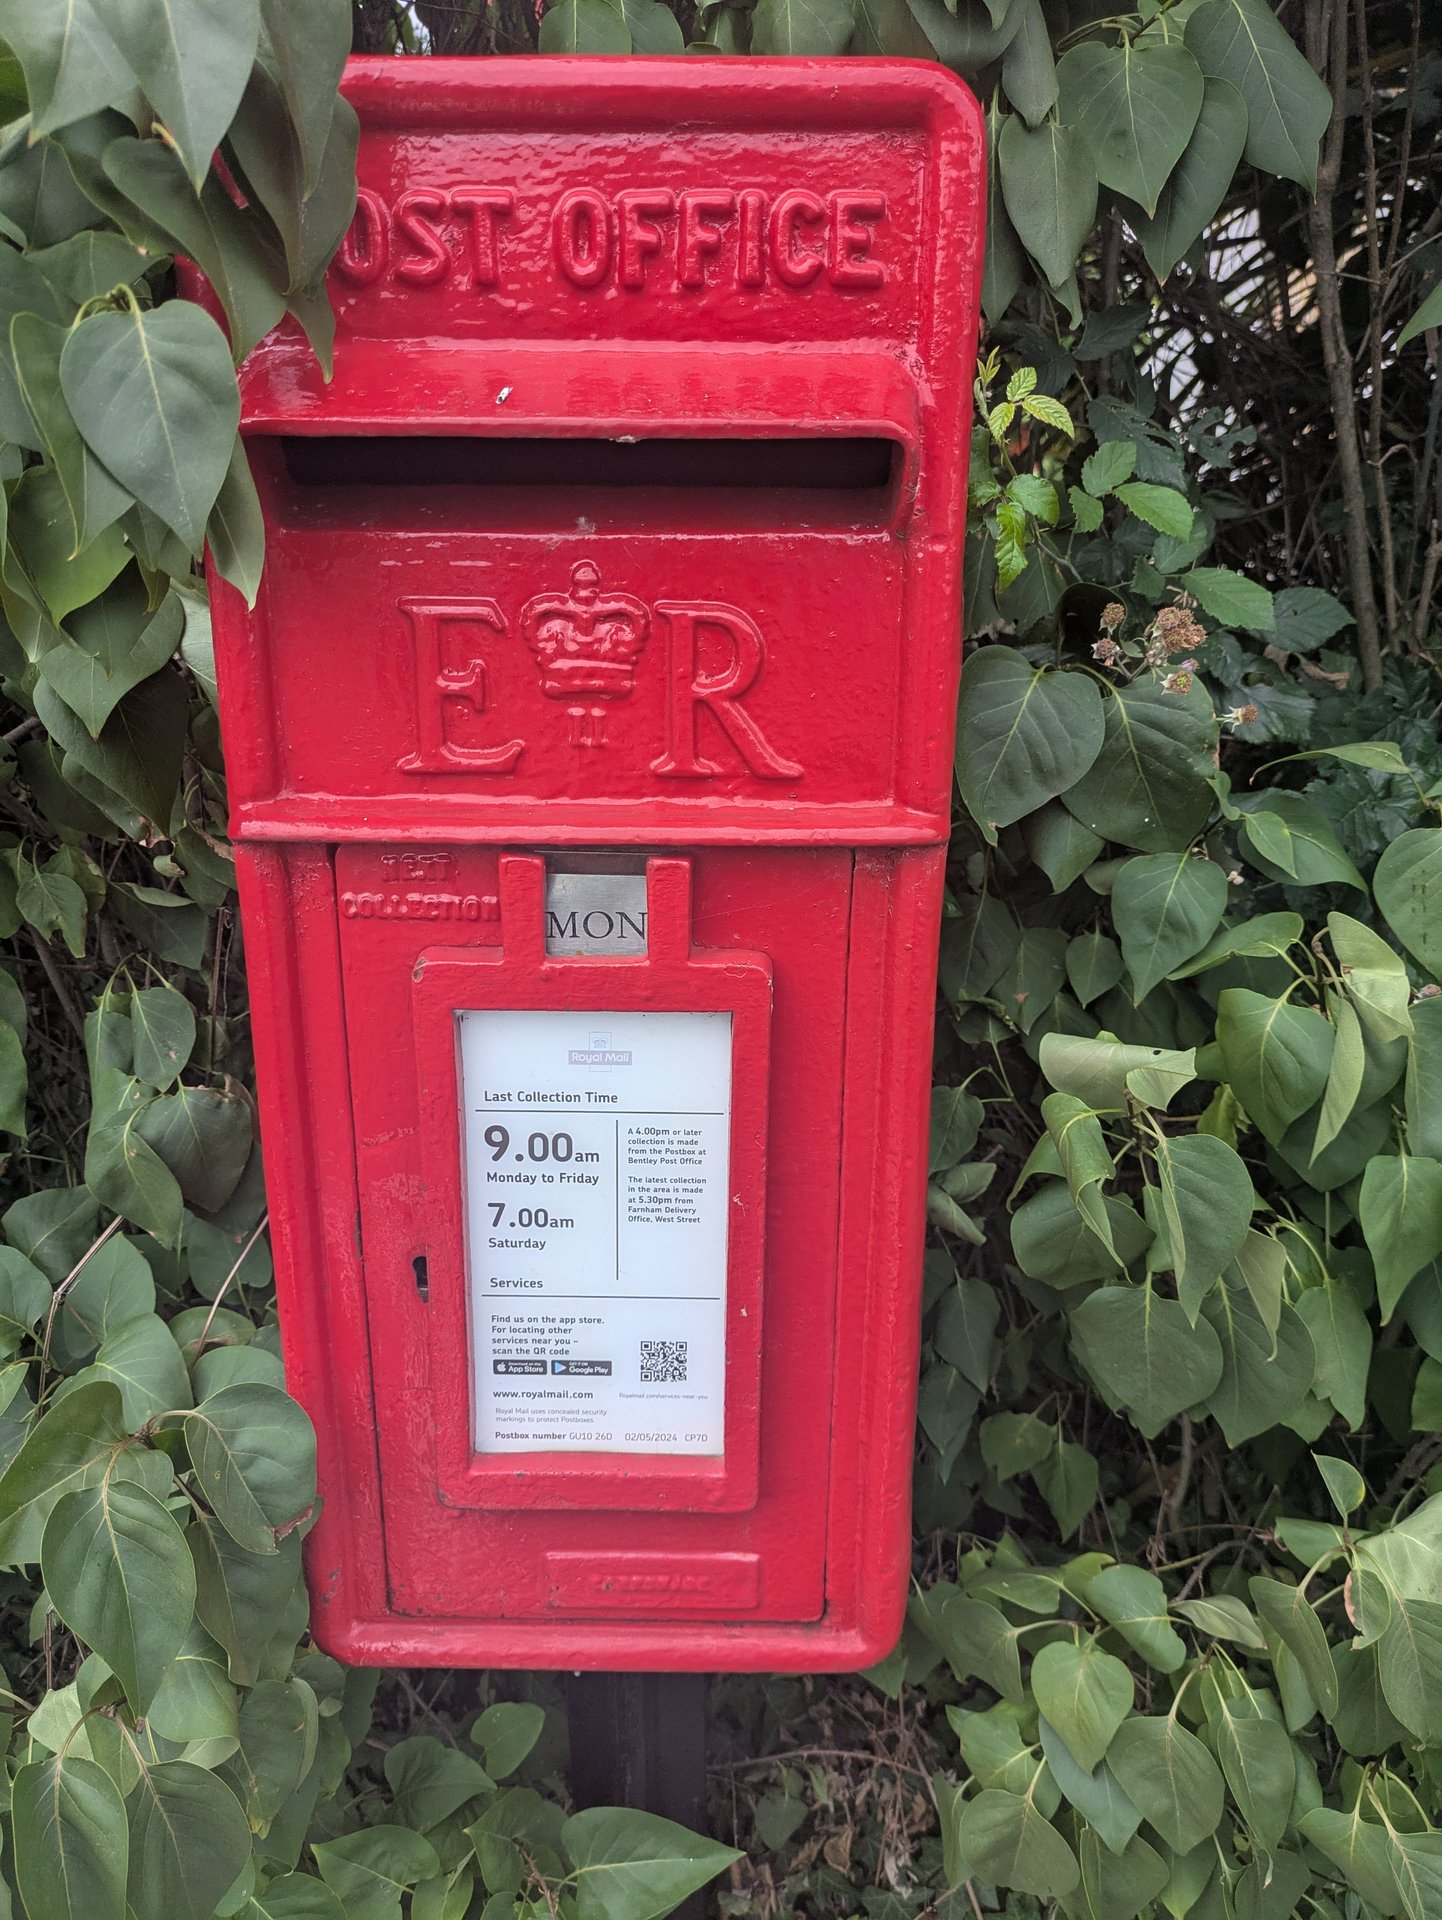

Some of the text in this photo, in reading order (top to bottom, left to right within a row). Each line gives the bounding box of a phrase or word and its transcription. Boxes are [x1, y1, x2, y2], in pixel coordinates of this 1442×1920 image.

[330, 186, 887, 288] OST OFFICE
[396, 595, 804, 779] E R
[341, 891, 500, 922] COLLECTION
[546, 910, 648, 940] MON
[571, 1051, 629, 1063] Royal Mail
[484, 1090, 618, 1104] Last Collection Time
[635, 1127, 670, 1138] 4.00pm
[483, 1125, 600, 1163] 9.00am
[628, 1137, 699, 1146] collection is made
[628, 1147, 707, 1156] from the Postbox at
[628, 1156, 703, 1167] Bentley Post Office
[486, 1171, 600, 1187] Monday to Friday
[628, 1175, 707, 1185] The latest collection
[628, 1185, 704, 1194] in the area is made
[628, 1195, 694, 1206] at 5.30pm from
[487, 1202, 575, 1229] 7.00am
[628, 1205, 697, 1216] Farnham Delivery
[628, 1214, 701, 1224] Office, West Street
[488, 1237, 547, 1251] Saturday
[490, 1277, 544, 1289] Services
[491, 1315, 605, 1326] Find us on the app store.
[491, 1325, 573, 1337] For locating other
[492, 1336, 529, 1346] services
[531, 1337, 552, 1346] near
[555, 1337, 571, 1348] you
[492, 1346, 570, 1356] scan the QR code
[569, 1366, 608, 1375] Google Play
[493, 1390, 594, 1401] www.royalmail.com
[495, 1407, 514, 1417] Royal
[516, 1407, 529, 1415] Mail
[548, 1408, 580, 1416] concealed
[582, 1408, 607, 1417] security
[496, 1416, 525, 1425] markings
[536, 1416, 559, 1425] protect
[561, 1416, 594, 1424] Postboxes
[495, 1431, 530, 1440] Postbox
[532, 1432, 567, 1440] number
[569, 1432, 593, 1441] GU10
[624, 1432, 678, 1442] 02/05/2024
